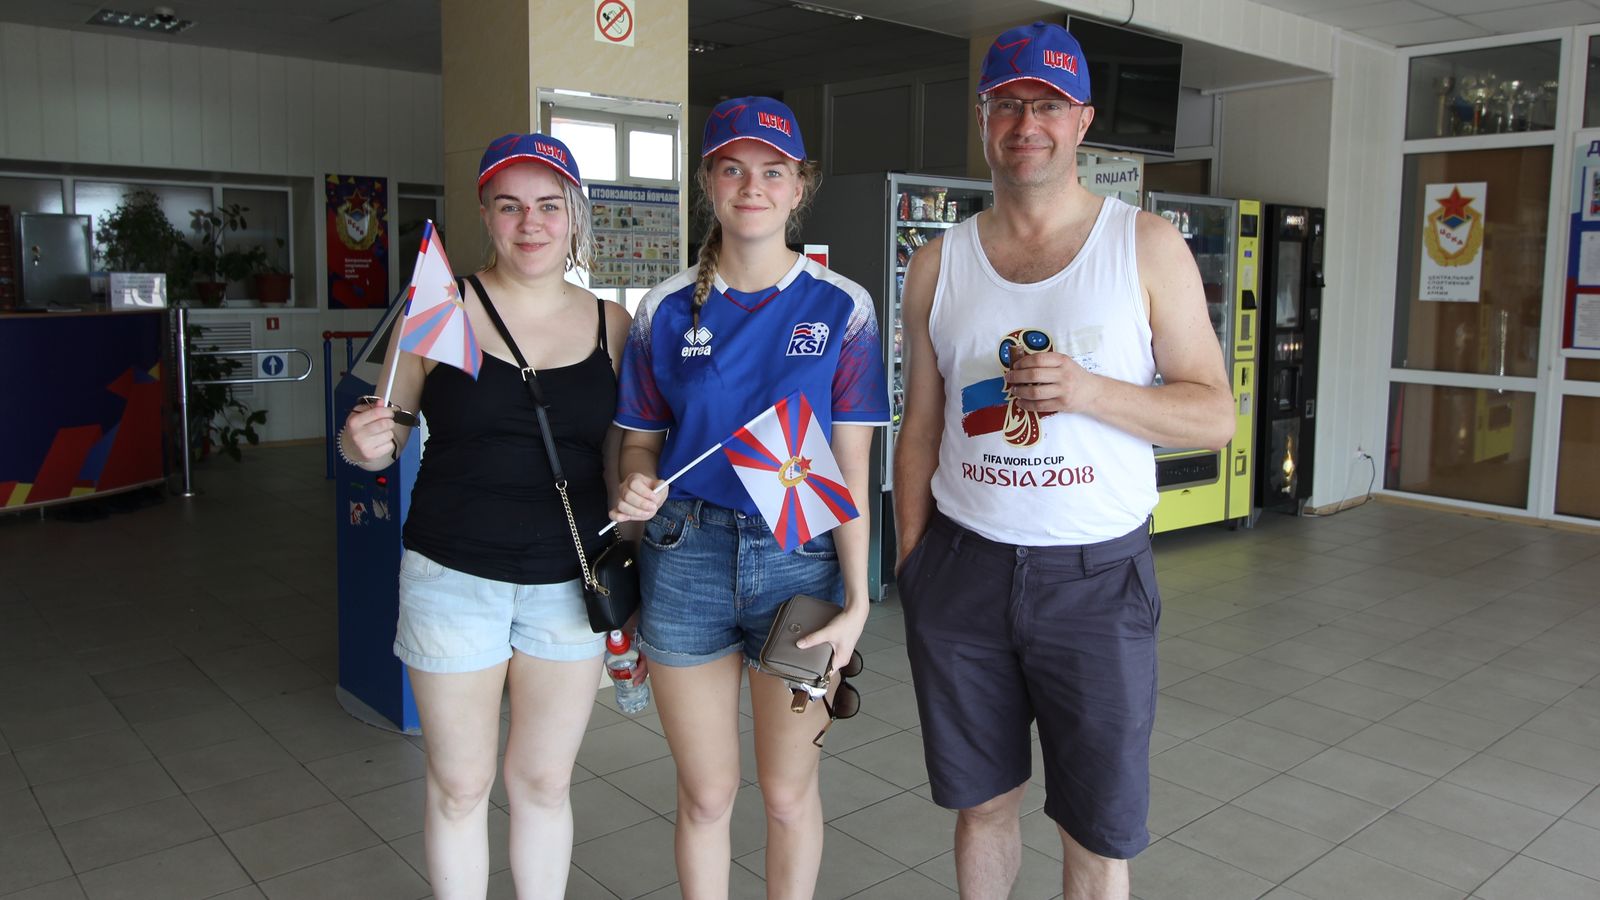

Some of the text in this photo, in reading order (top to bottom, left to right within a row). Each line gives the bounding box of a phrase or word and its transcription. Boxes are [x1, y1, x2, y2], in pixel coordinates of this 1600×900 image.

[1044, 49, 1078, 76] ЦСКА
[758, 111, 792, 137] ЦСКА
[535, 141, 568, 167] ЦСКА
[1440, 228, 1464, 246] ЦСКА
[983, 454, 1065, 466] FIFA WORLD CUP
[962, 462, 1095, 487] RUSSIA 2018
